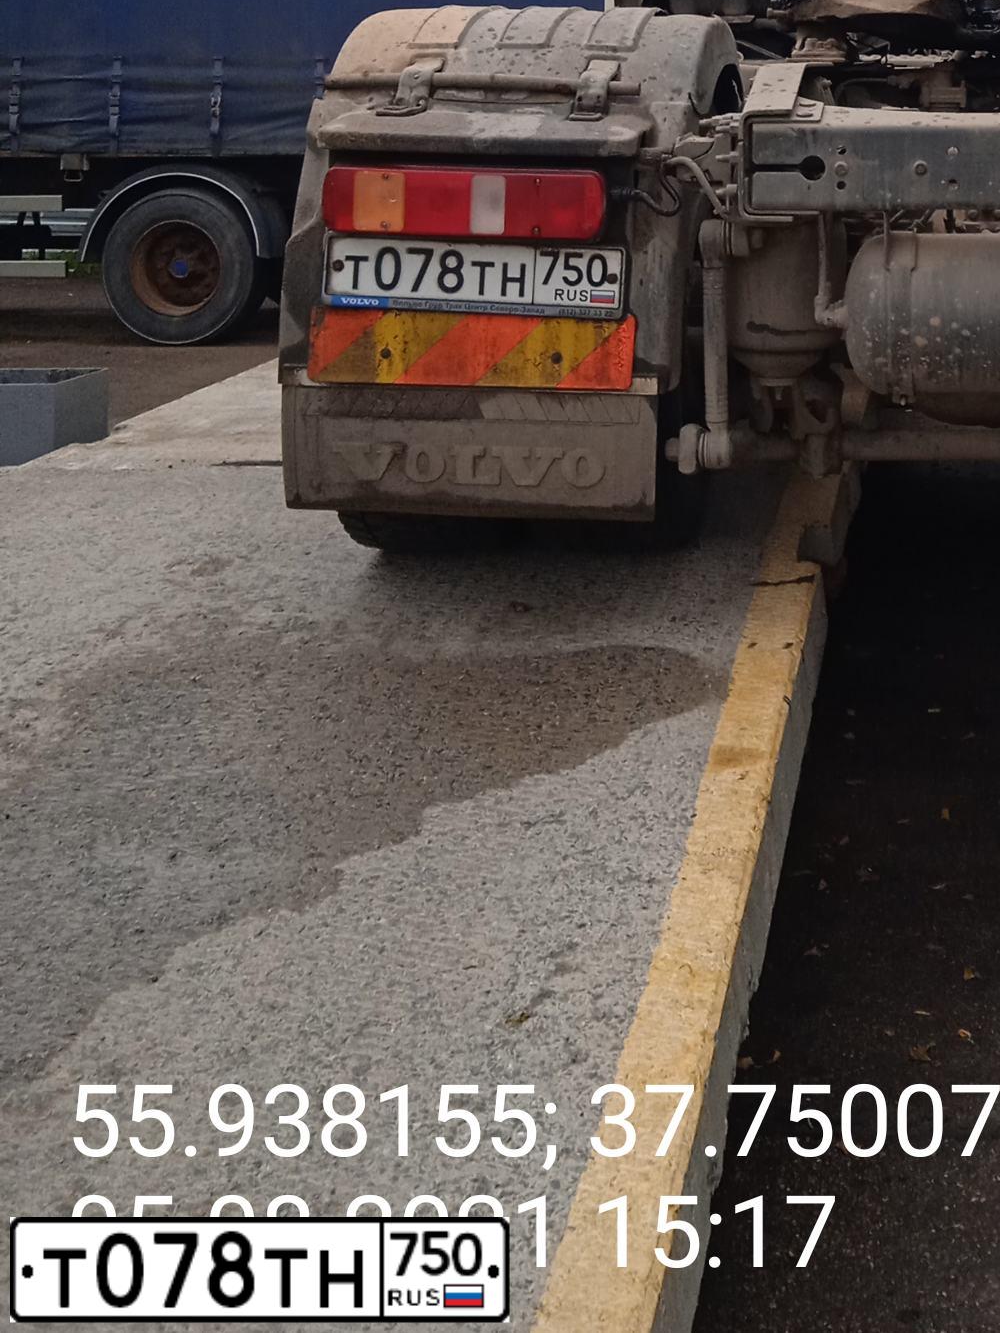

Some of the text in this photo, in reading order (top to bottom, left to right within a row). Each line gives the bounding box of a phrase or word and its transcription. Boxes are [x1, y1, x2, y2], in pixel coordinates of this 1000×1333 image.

[539, 250, 608, 288] 750
[340, 297, 379, 306] VOLVO
[553, 288, 589, 302] RUS
[331, 441, 606, 489] VOLVO
